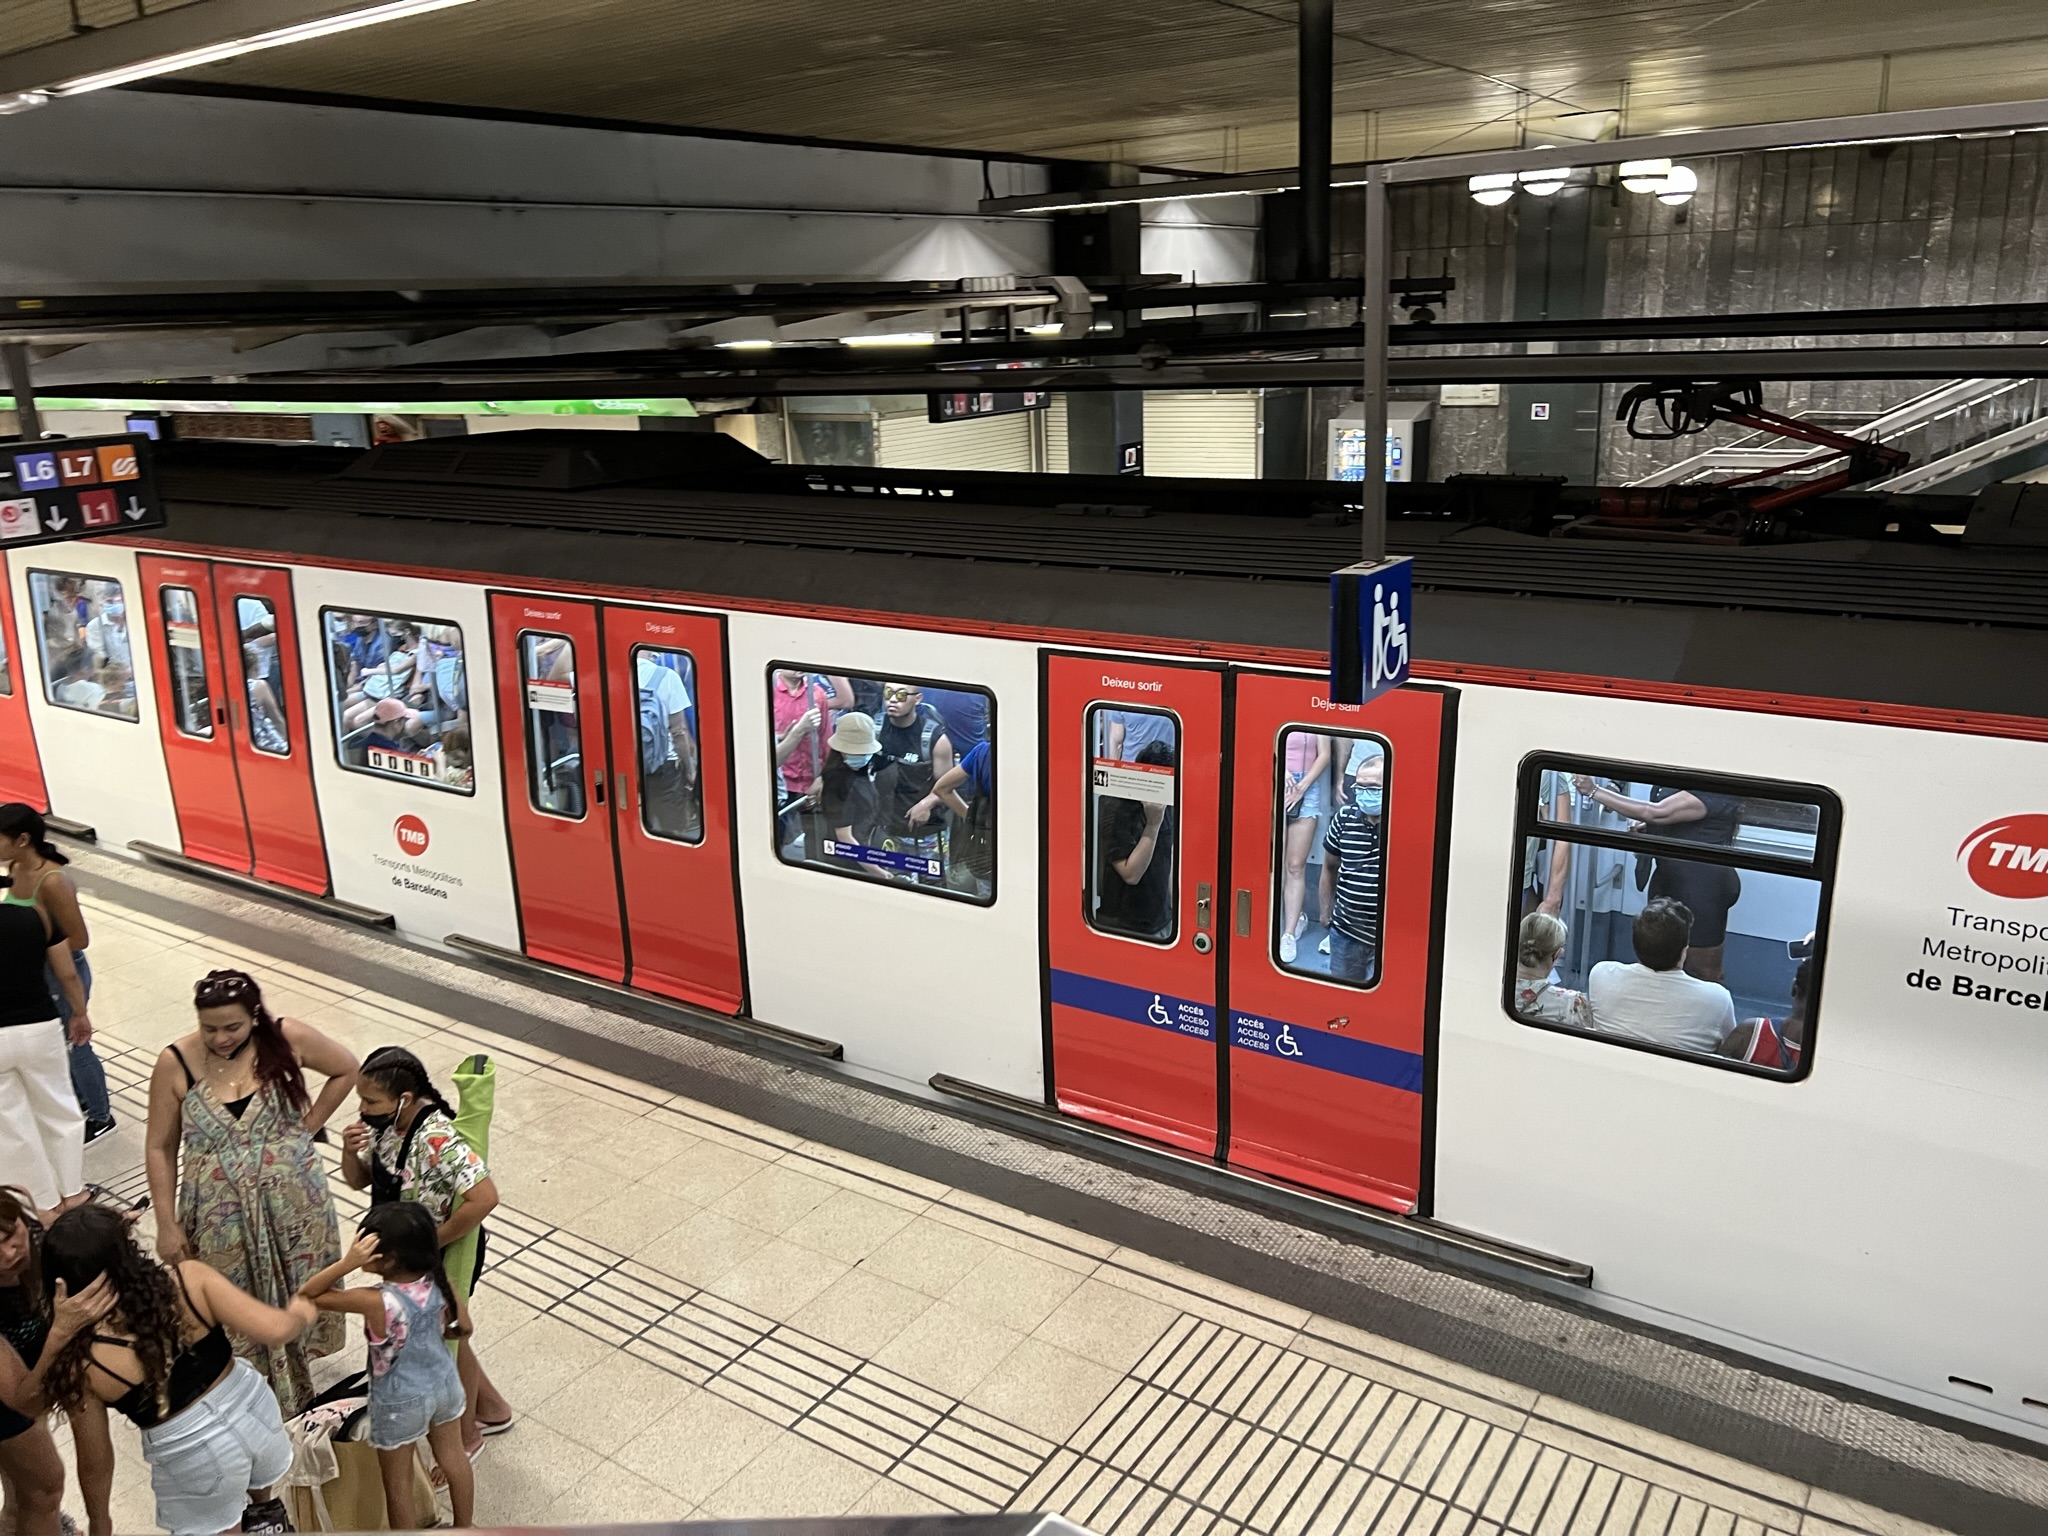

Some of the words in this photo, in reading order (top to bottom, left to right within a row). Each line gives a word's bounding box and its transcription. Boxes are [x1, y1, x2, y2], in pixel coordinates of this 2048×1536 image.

[19, 460, 56, 482] L6
[61, 456, 94, 478] L7
[81, 502, 112, 525] L1
[1101, 675, 1135, 689] Deixeu
[1137, 681, 1162, 692] sortir
[1311, 696, 1336, 712] Deje
[400, 827, 426, 846] TMB
[1988, 842, 2048, 874] TM
[391, 876, 402, 887] de
[404, 878, 448, 900] Barcelona
[1922, 937, 2048, 975] Metropoli
[1906, 969, 1942, 991] de
[1178, 1003, 1204, 1016] ACCÉS
[1178, 1013, 1210, 1027] ACCESO
[1237, 1017, 1264, 1030] ACCÉS
[1178, 1023, 1210, 1037] ACCESS
[1237, 1026, 1270, 1041] ACCESO
[1237, 1037, 1270, 1051] ACCESS
